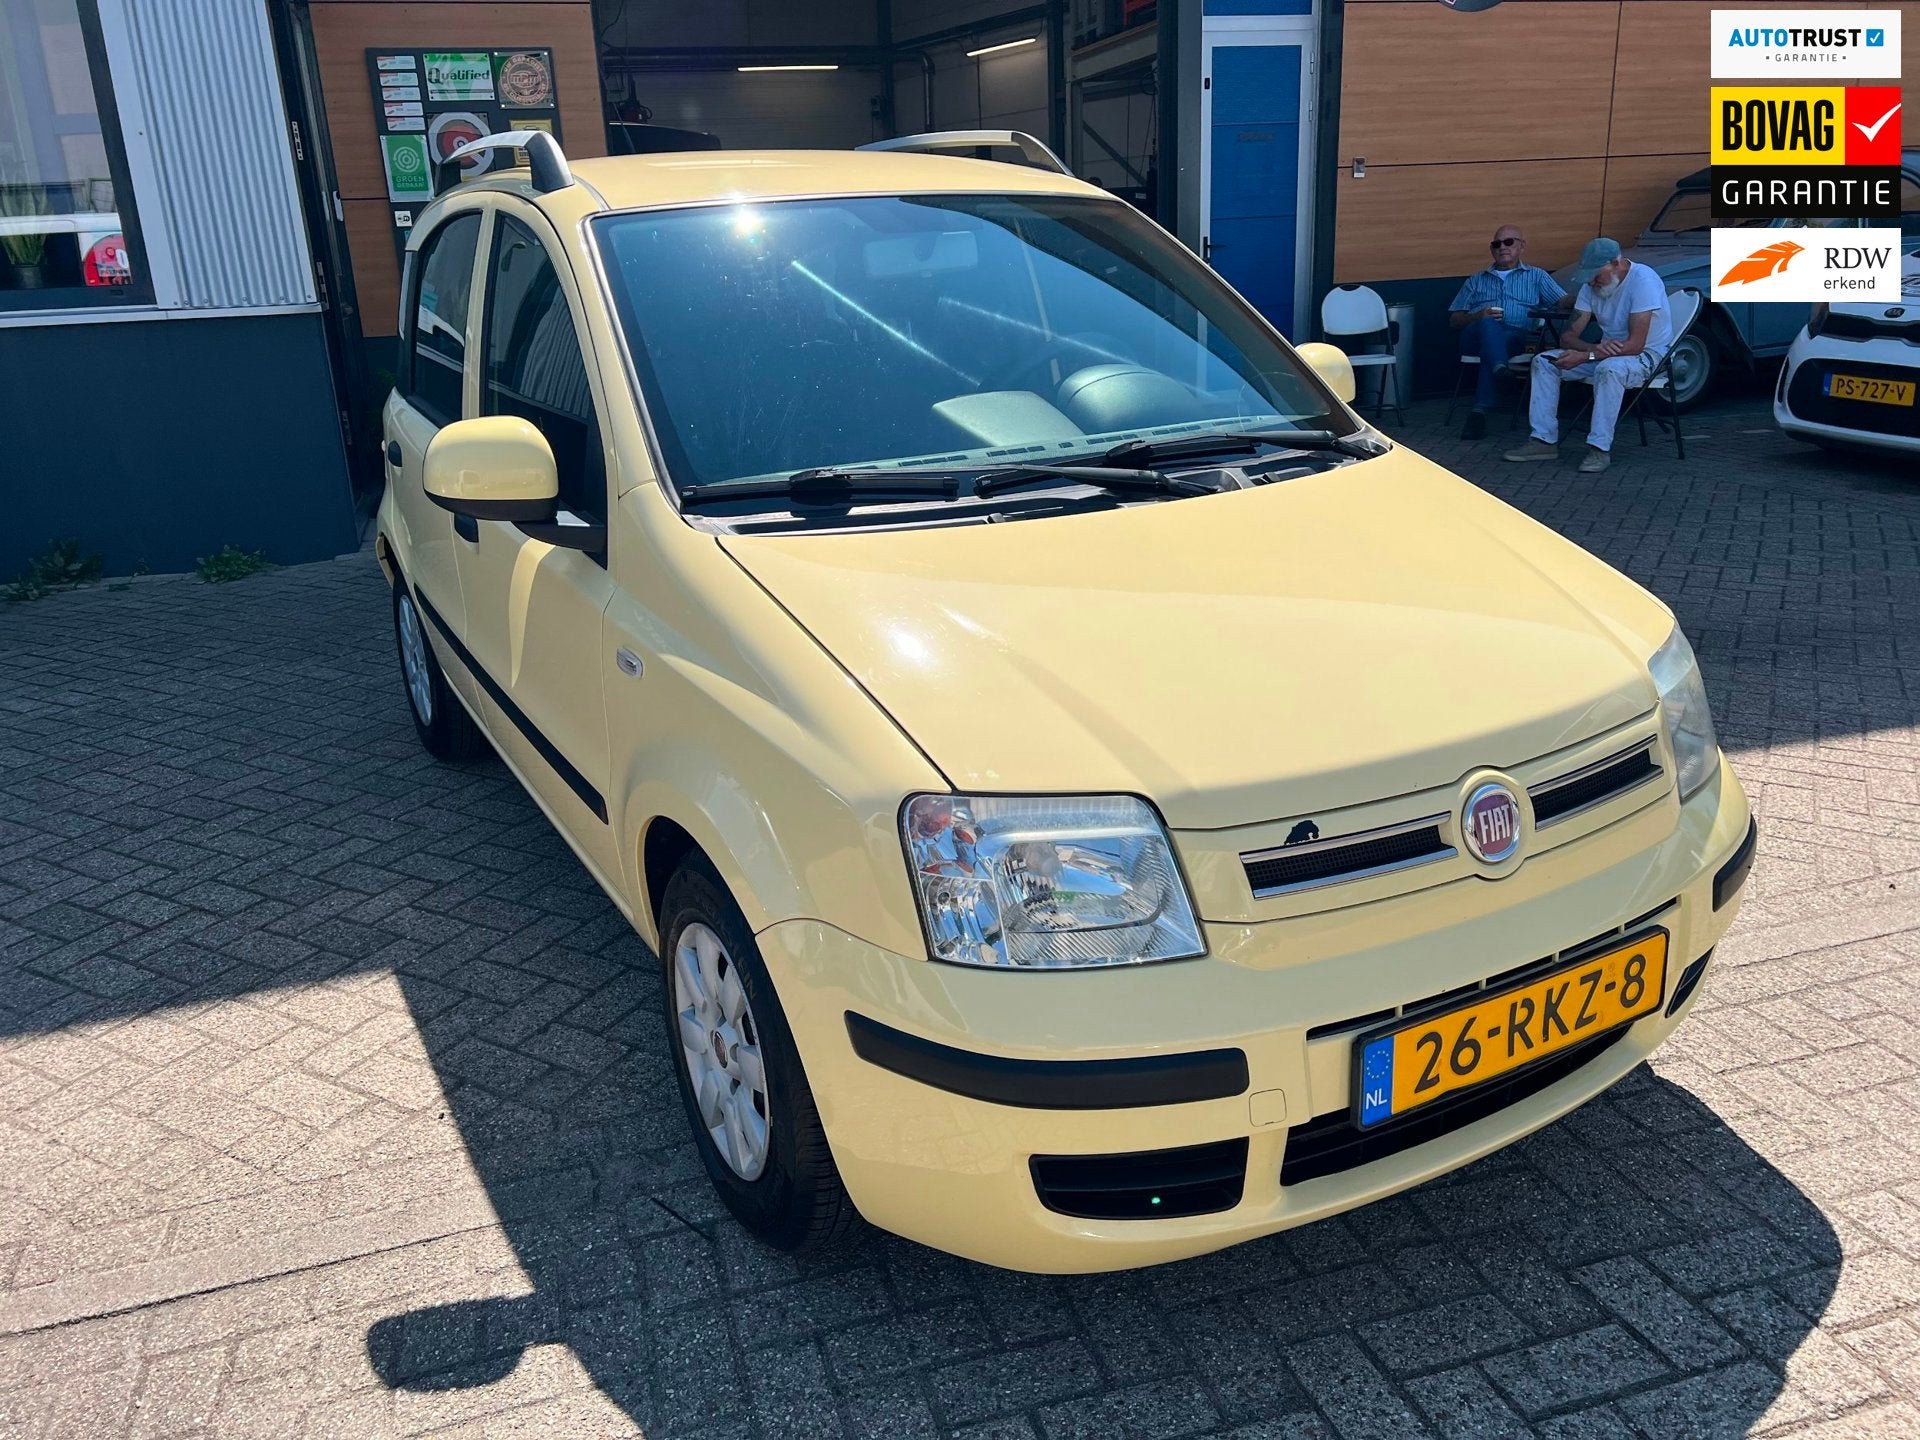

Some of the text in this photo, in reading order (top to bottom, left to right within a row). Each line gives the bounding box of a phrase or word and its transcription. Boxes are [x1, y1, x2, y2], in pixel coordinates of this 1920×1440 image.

[428, 67, 490, 84] Qualified
[396, 175, 425, 183] GROEN
[1835, 377, 1907, 401] PS-727-V
[1478, 804, 1511, 844] FIAT
[1414, 953, 1646, 1095] 26-RKZ-8
[1364, 1088, 1387, 1111] NL
